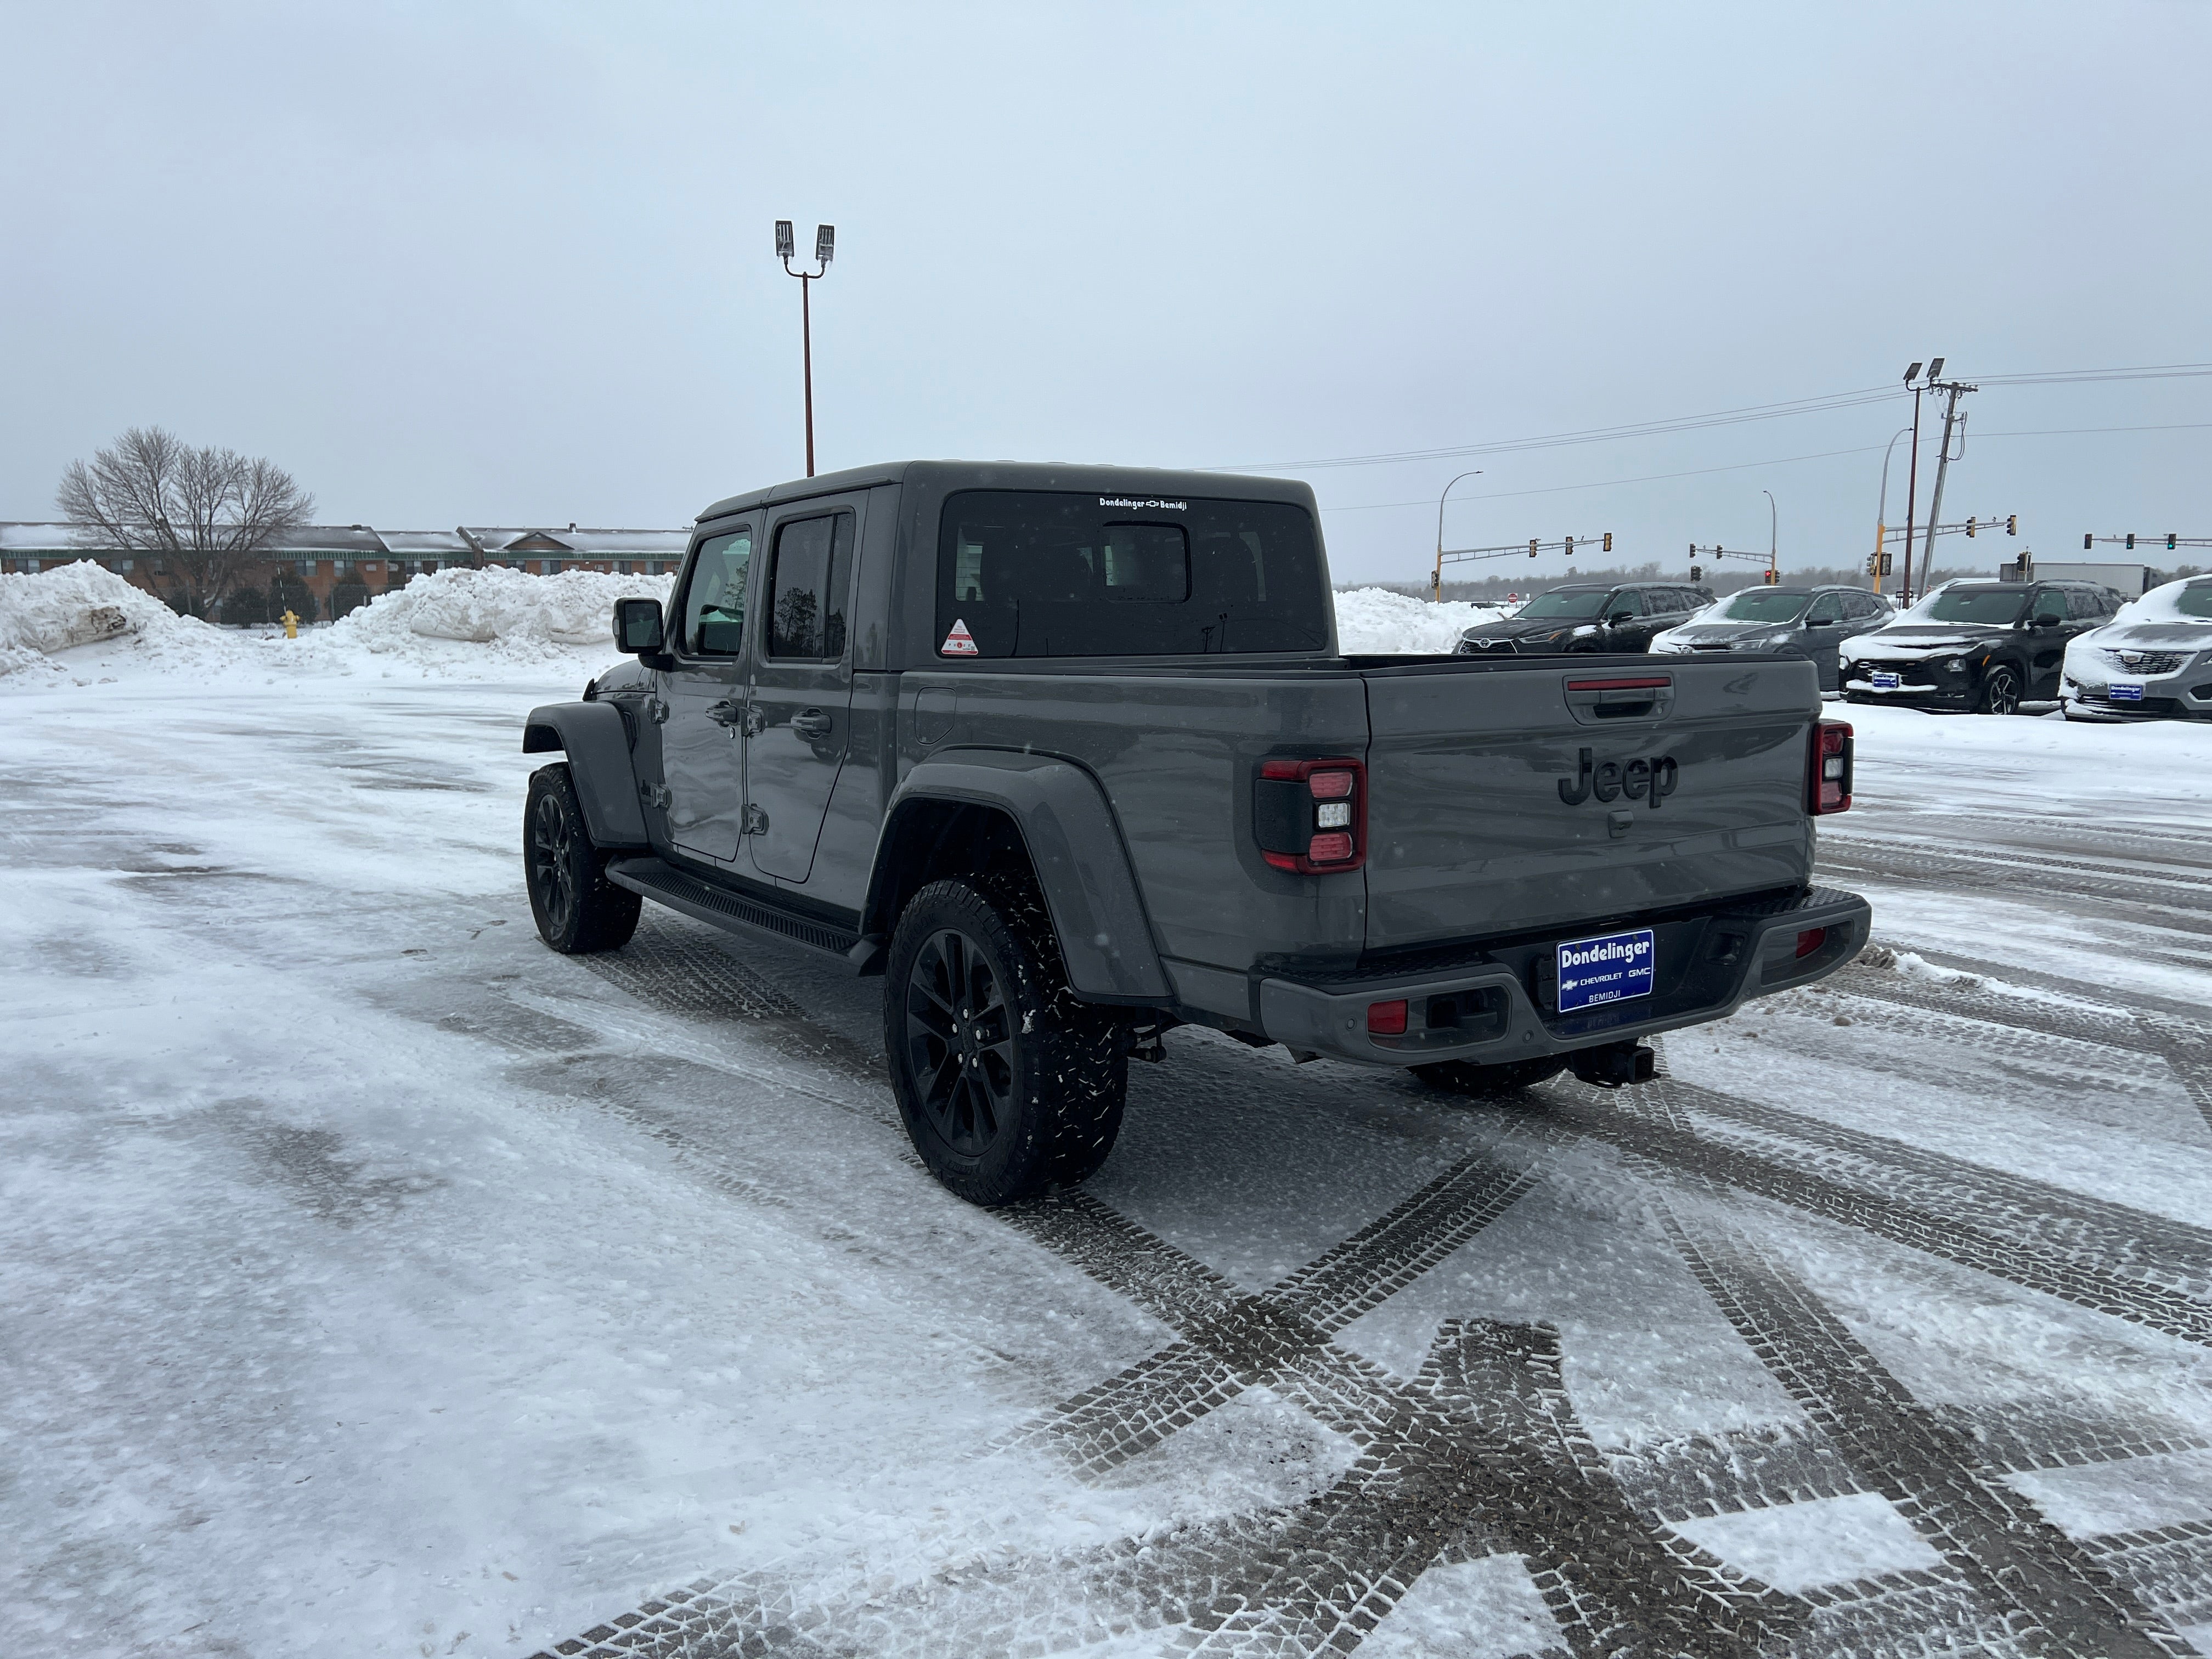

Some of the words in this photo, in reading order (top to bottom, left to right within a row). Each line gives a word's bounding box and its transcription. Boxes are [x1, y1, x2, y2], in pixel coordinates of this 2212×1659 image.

[1099, 498, 1145, 510] Dondelinger
[1160, 500, 1187, 511] Bemidji
[1558, 747, 1678, 809] Jeep
[1562, 941, 1650, 968] Dondelinger
[1580, 972, 1623, 986] CHEVROLET
[1628, 967, 1651, 978] GMC
[1589, 990, 1621, 1003] BEMIDJI
